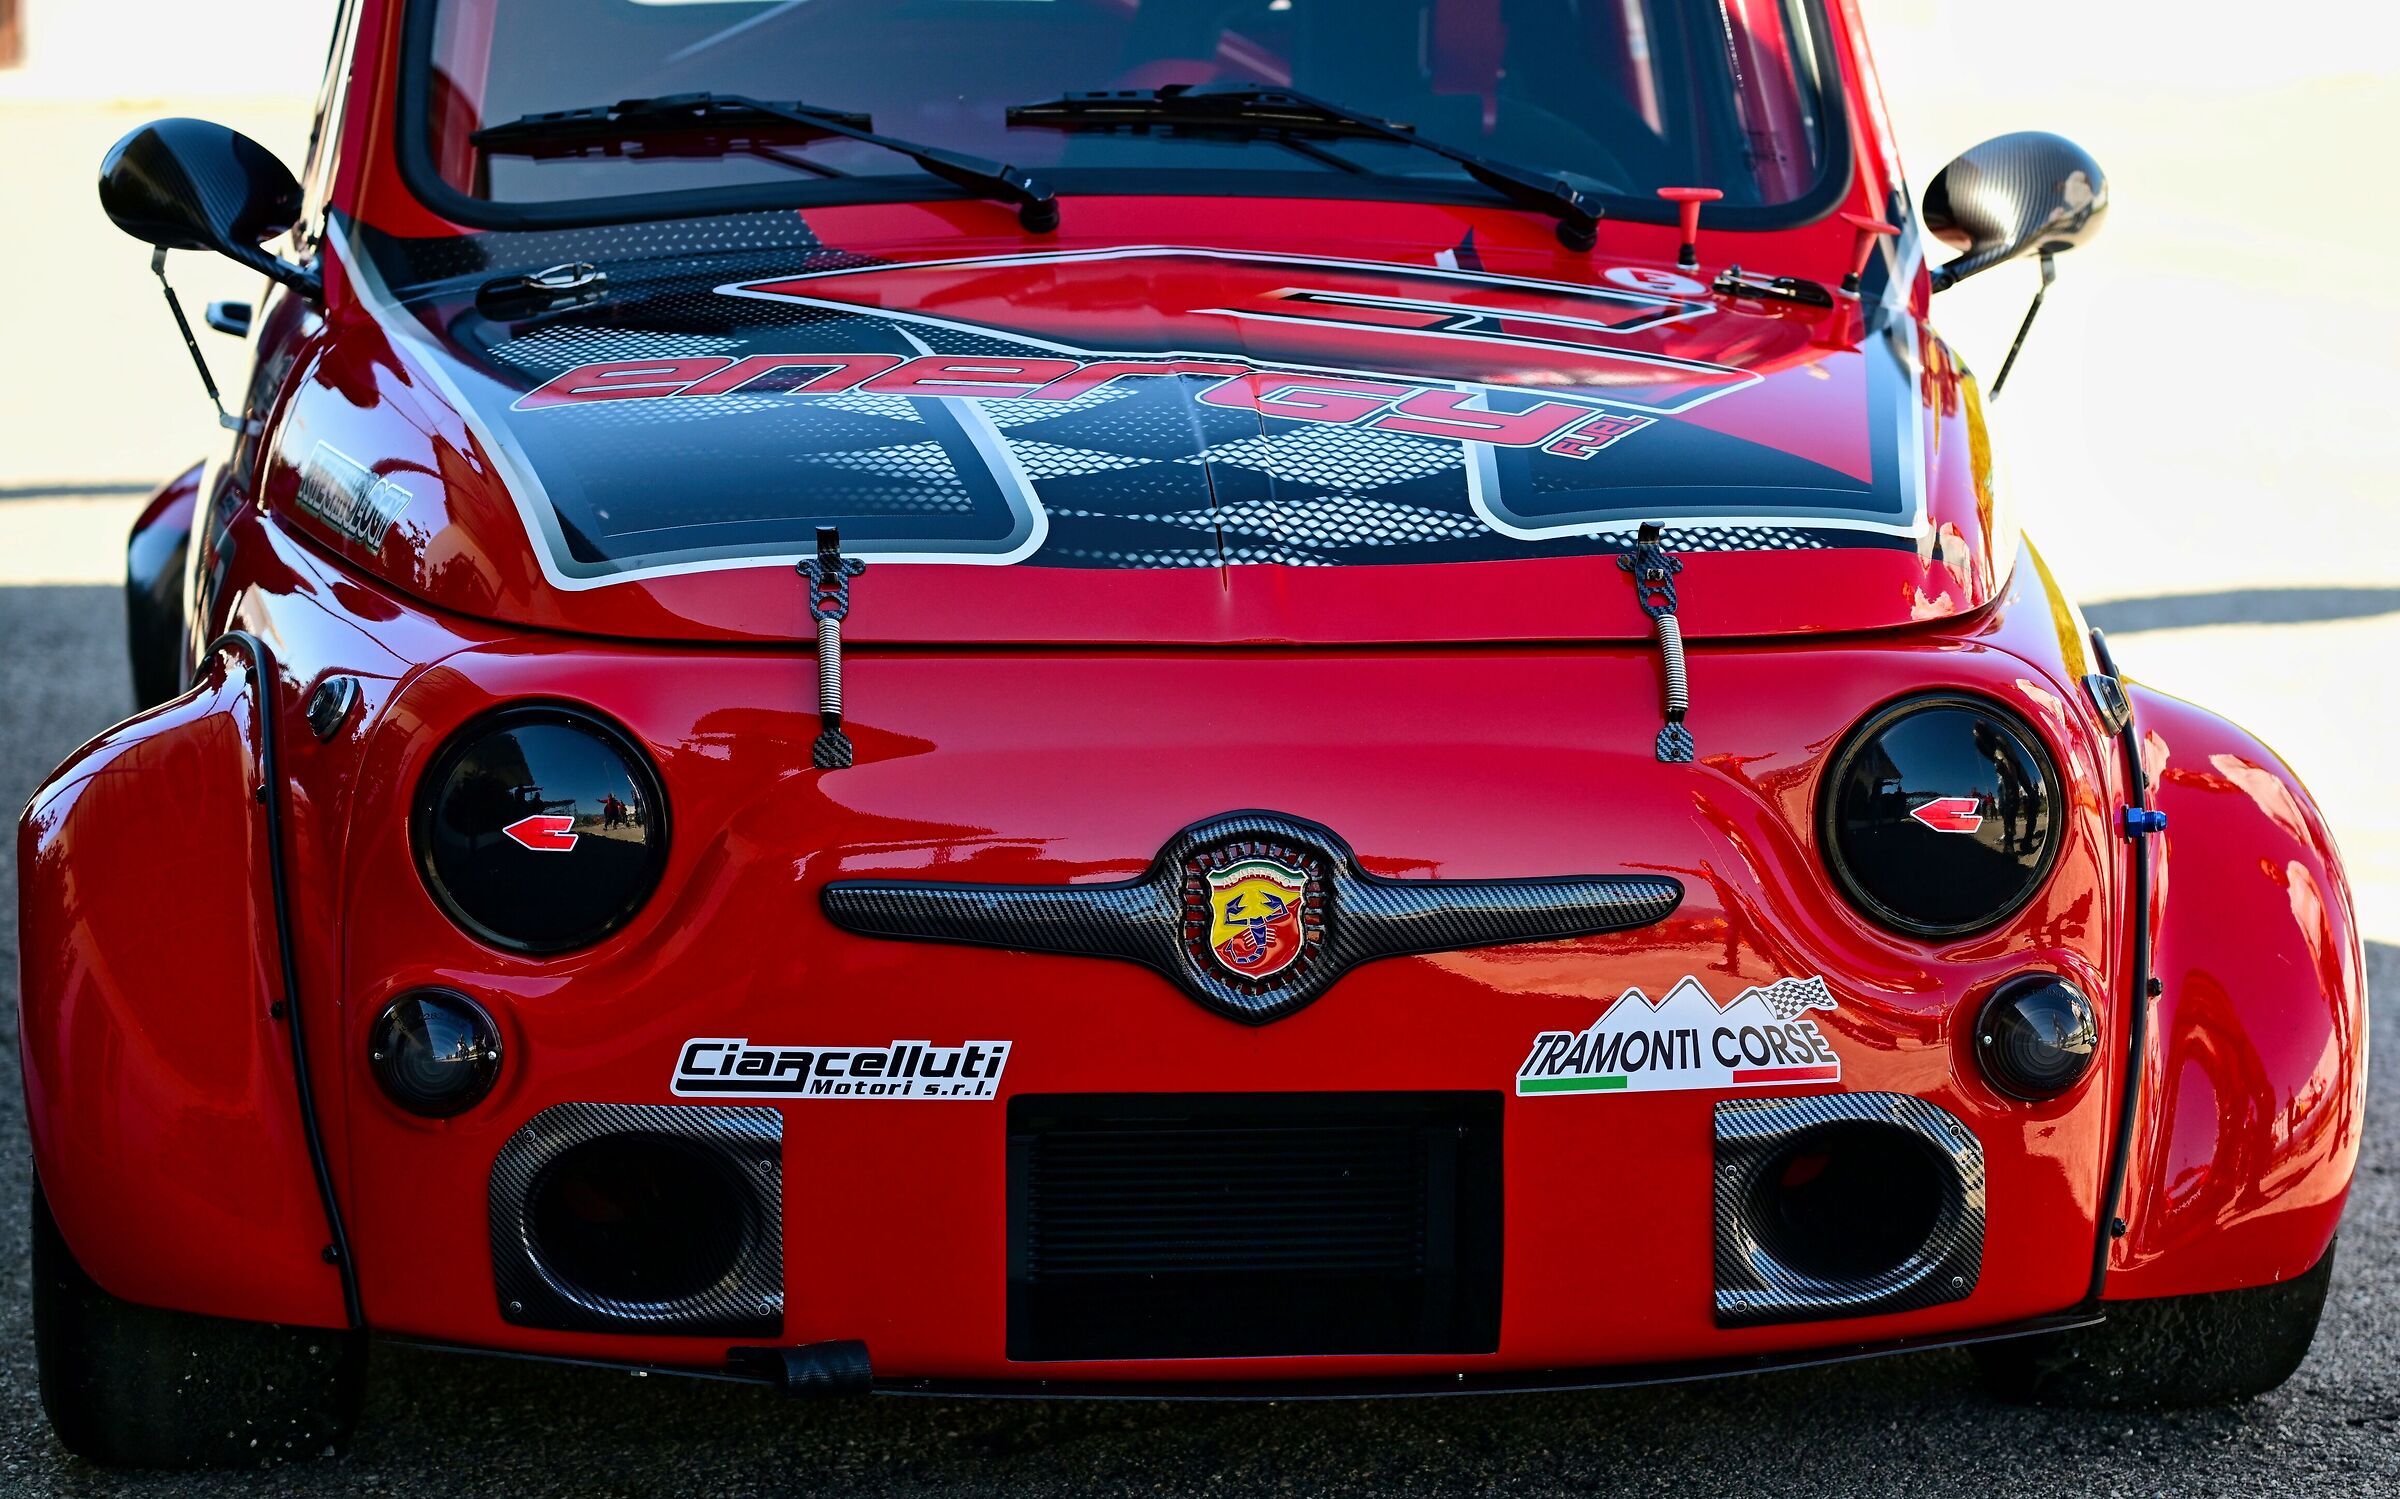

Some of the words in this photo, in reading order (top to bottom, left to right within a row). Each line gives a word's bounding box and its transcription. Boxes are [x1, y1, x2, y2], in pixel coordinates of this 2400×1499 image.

[1521, 1029, 1701, 1076] TRAMONTI
[1711, 1022, 1837, 1068] CORSE
[809, 1079, 912, 1095] Motori
[923, 1080, 992, 1096] s.r.l.
